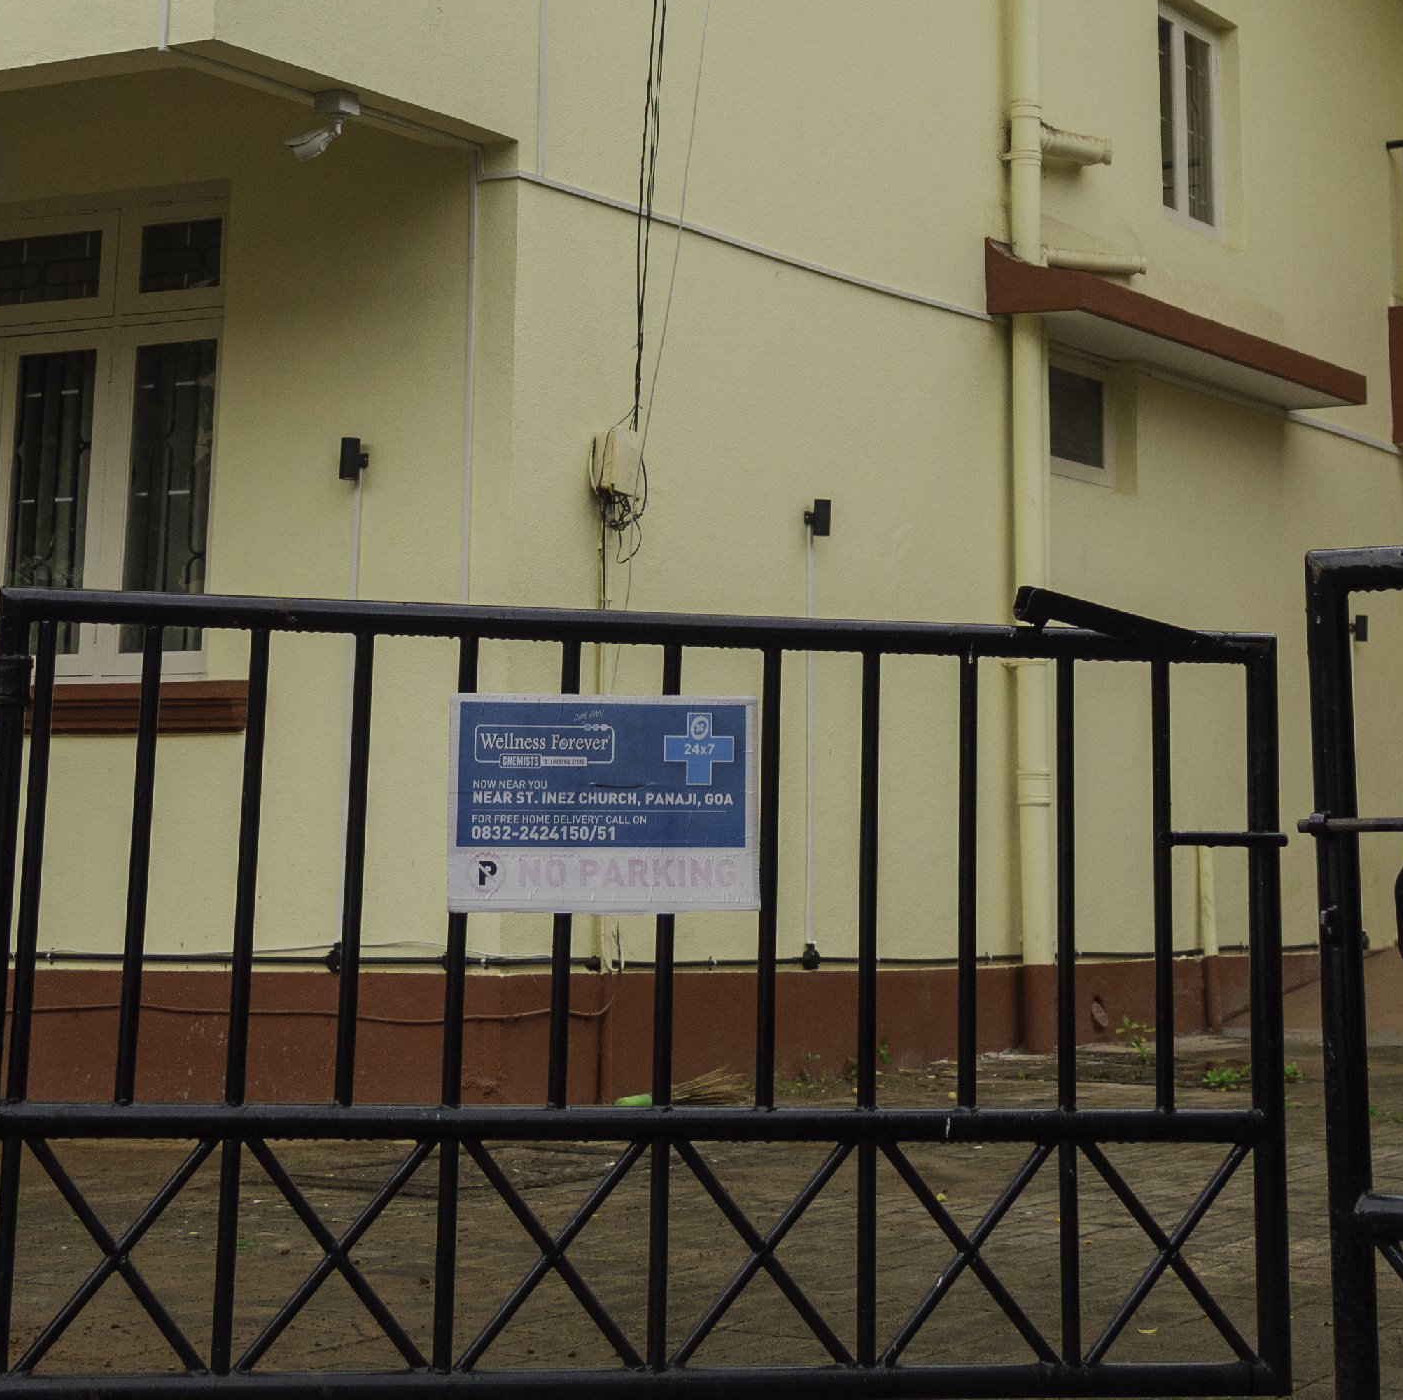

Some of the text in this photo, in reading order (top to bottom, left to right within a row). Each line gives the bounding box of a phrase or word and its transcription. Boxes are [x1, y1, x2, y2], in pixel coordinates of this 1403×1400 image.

[480, 732, 609, 750] Wellness Forever
[684, 743, 715, 755] 24x7
[502, 755, 539, 767] CHEMISTS
[472, 779, 548, 790] NOW NEAR YOU
[472, 790, 733, 808] NEAR ST. INEZ CHURCH, PANAJI, GOA
[471, 814, 492, 824] FOR
[494, 814, 520, 824] FREE
[522, 814, 551, 824] HOME
[606, 814, 630, 824] CALL
[632, 814, 647, 825] ON
[471, 825, 616, 841] 0832-2424150/51
[518, 858, 567, 888] NO
[579, 859, 737, 888] PARKING
